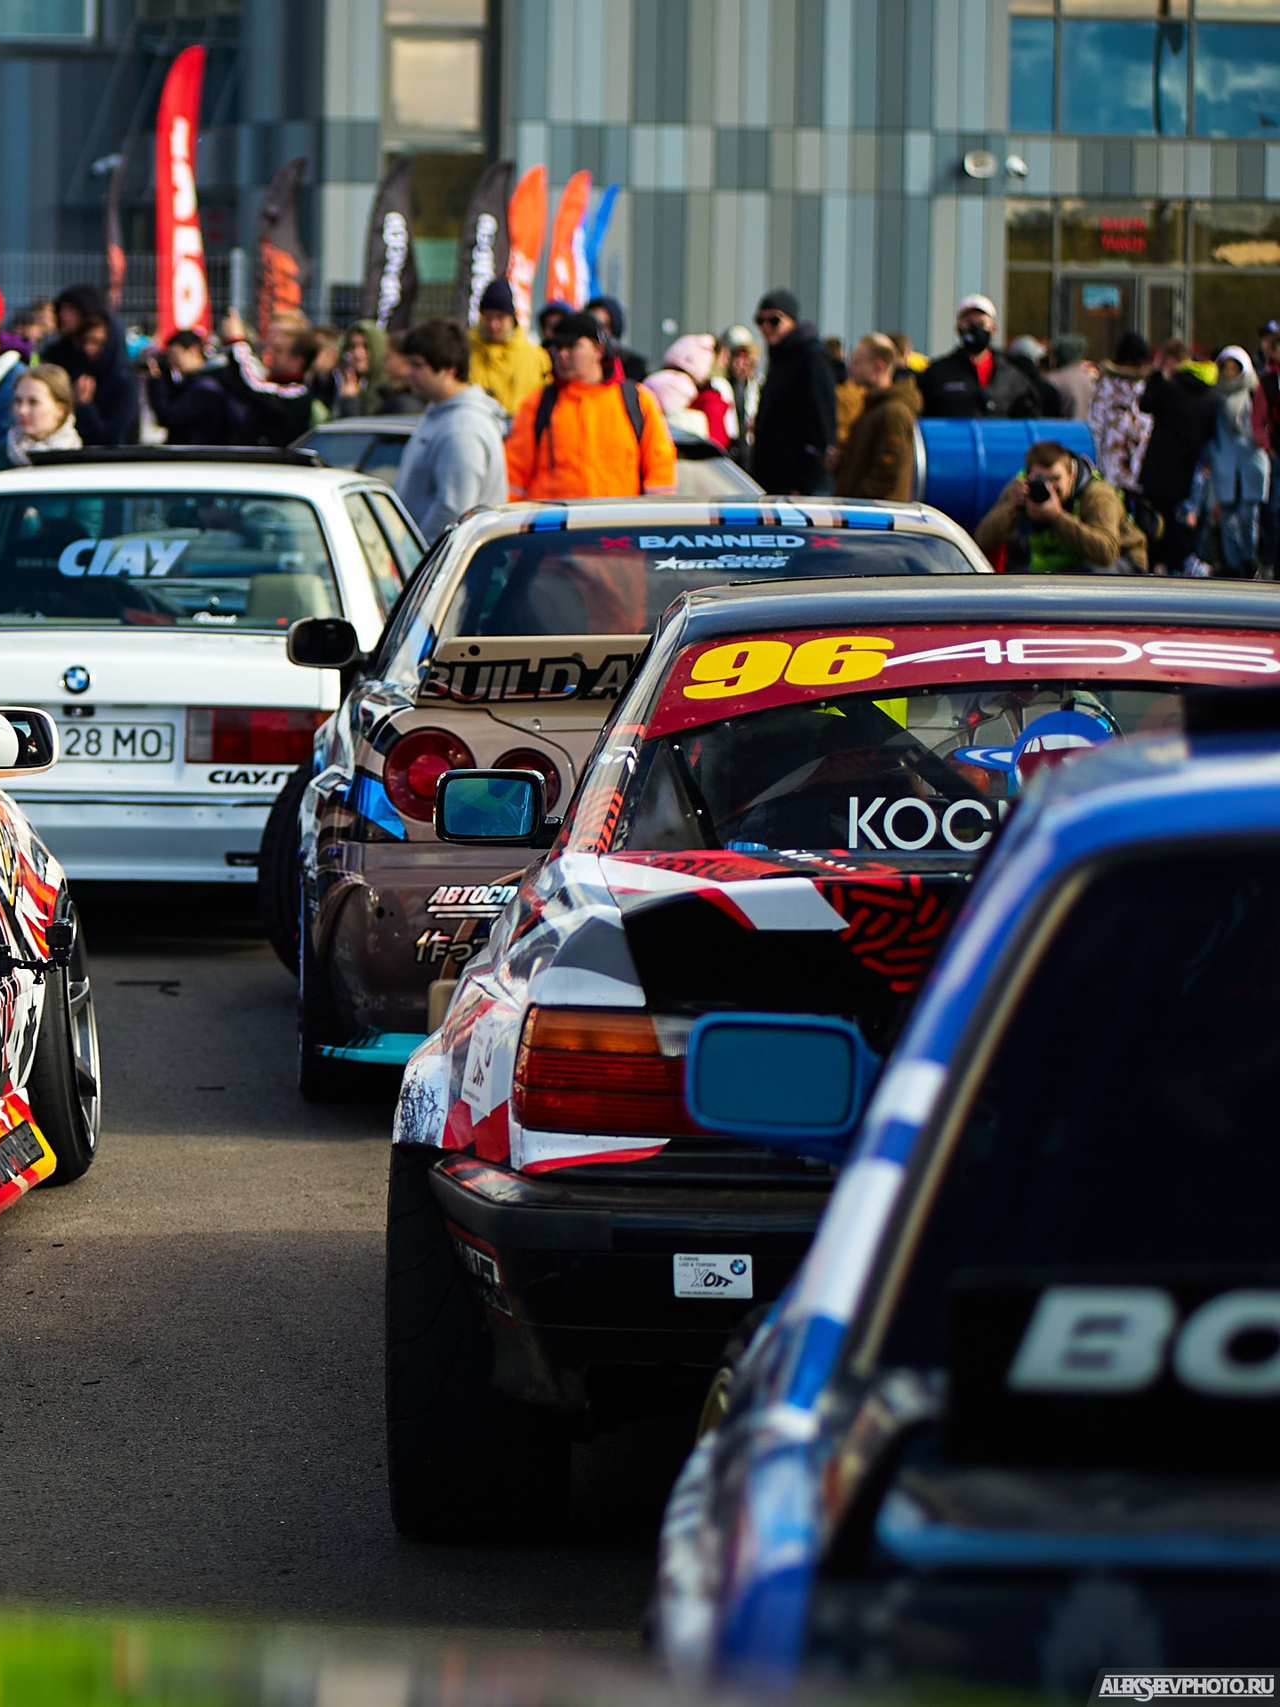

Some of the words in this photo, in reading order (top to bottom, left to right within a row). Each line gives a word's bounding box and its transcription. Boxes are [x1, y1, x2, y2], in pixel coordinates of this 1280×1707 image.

[639, 534, 806, 549] BANNED
[418, 659, 584, 704] BUILD
[586, 654, 640, 700] A
[683, 636, 895, 700] 96
[65, 727, 102, 757] 28
[848, 796, 1008, 852] KOC
[427, 885, 520, 905] АВТОСП
[416, 929, 490, 962] 作っ
[1007, 1284, 1280, 1396] BO
